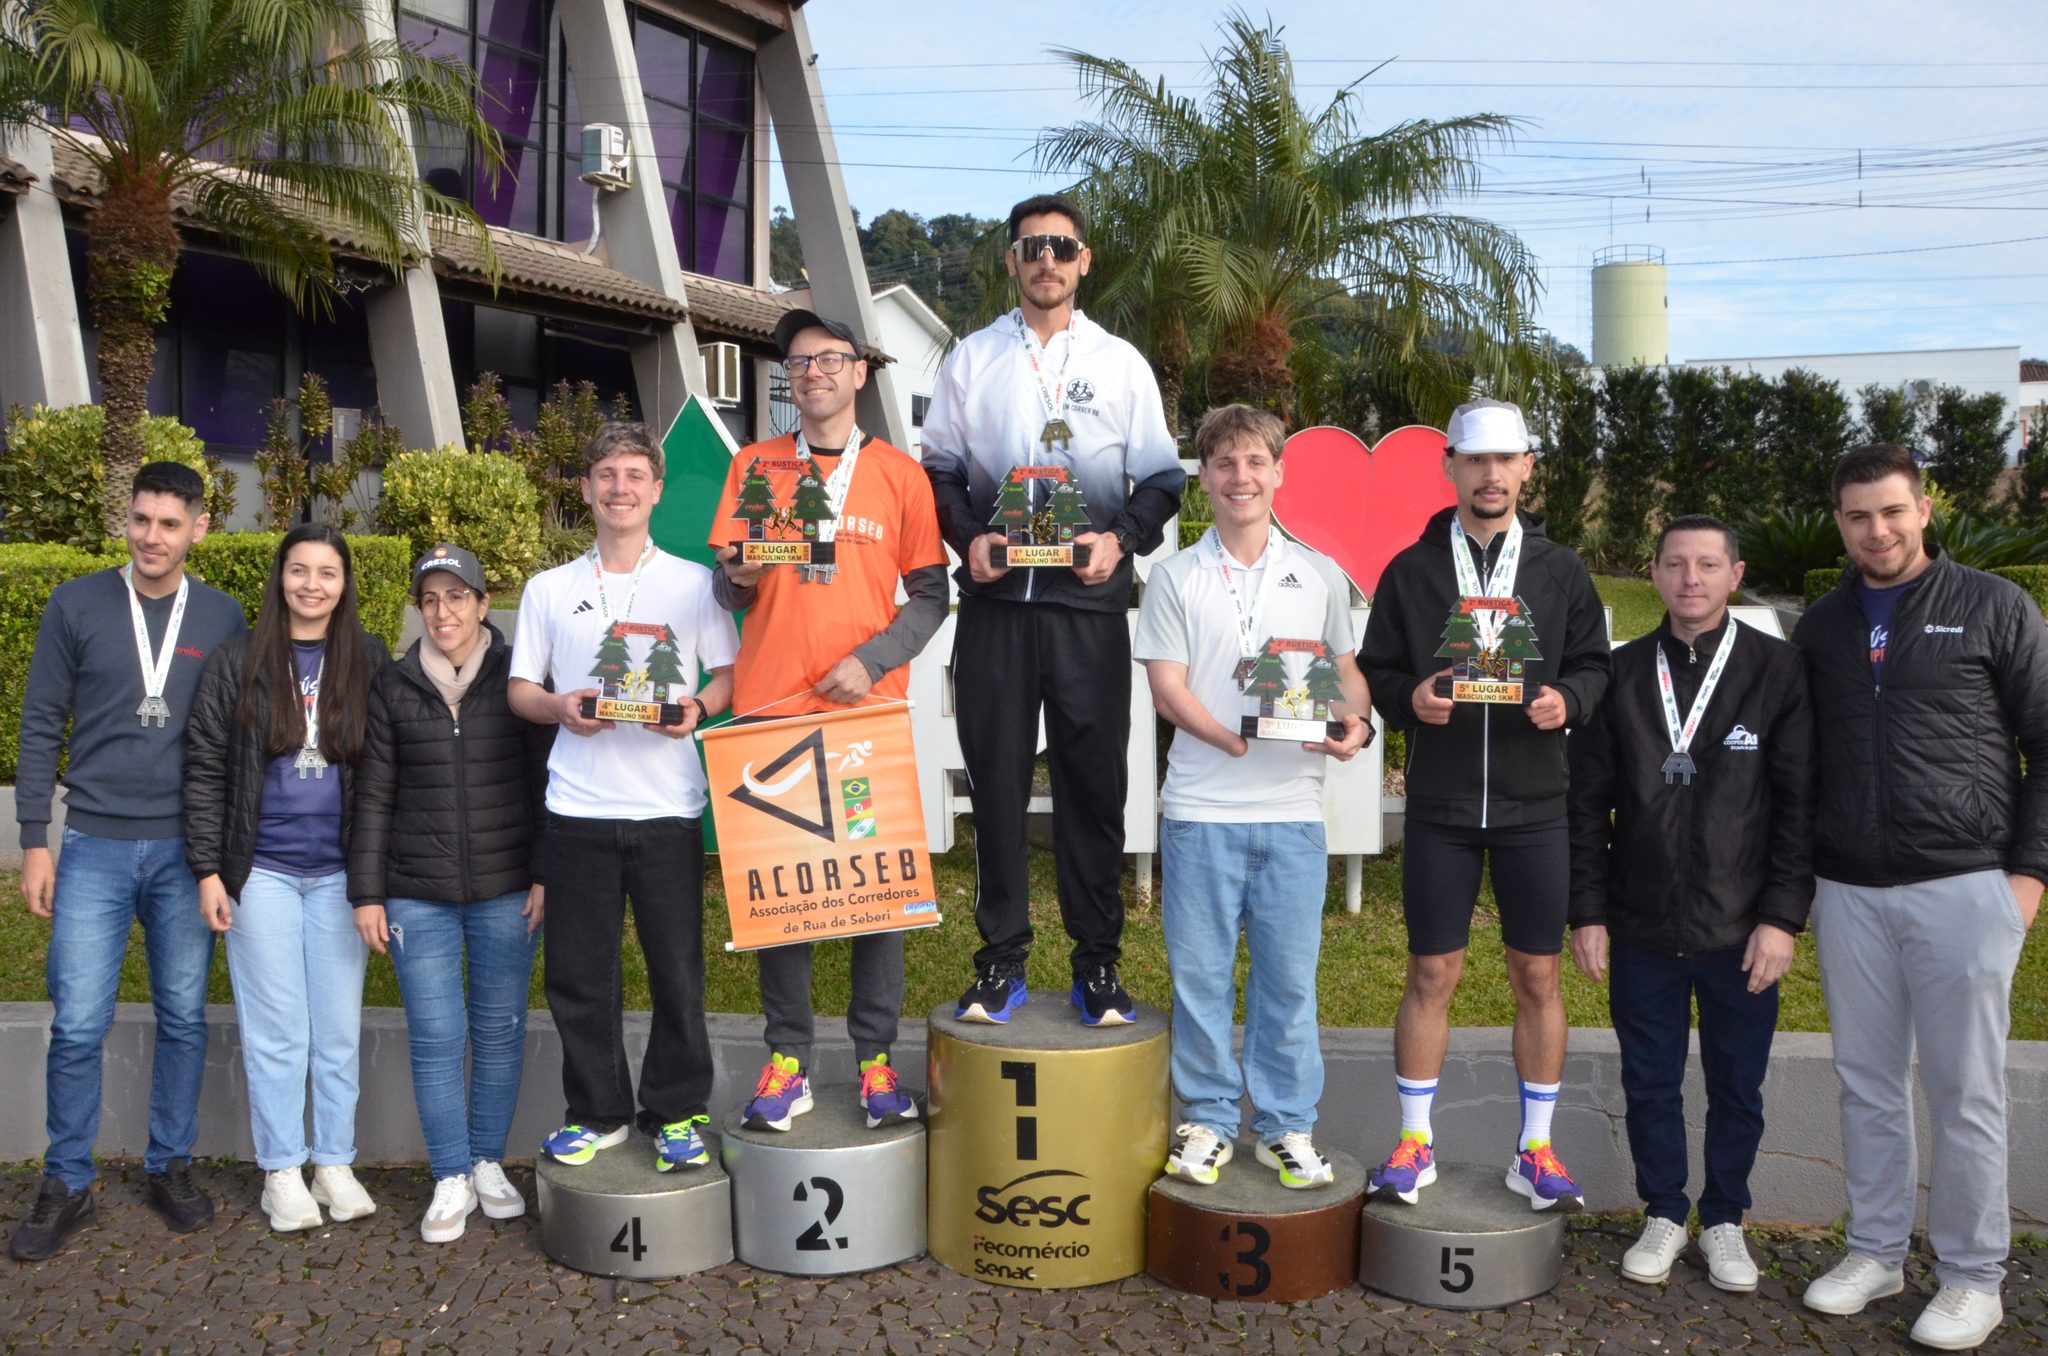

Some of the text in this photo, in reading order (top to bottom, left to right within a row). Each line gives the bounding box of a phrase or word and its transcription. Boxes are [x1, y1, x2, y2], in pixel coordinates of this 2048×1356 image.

[836, 515, 884, 540] ORSEB
[747, 554, 786, 562] MASCULINO
[762, 545, 797, 554] LUGAR
[1010, 557, 1049, 565] MASCULINO
[1025, 549, 1060, 557] LUGAR
[421, 557, 462, 570] CRESOL
[1934, 625, 1964, 634] Sicredi
[1456, 692, 1514, 702] MASCULINO 5KM
[1472, 684, 1509, 694] LUGAR
[599, 710, 652, 721] MASCULINO 5KM
[614, 703, 648, 713] LUGAR
[747, 848, 918, 902] ACORSEB
[749, 887, 920, 918] Associação dos Corredores
[783, 909, 891, 934] de Rua de Seberi
[1001, 1060, 1038, 1161] 1
[792, 1176, 849, 1250] 2
[974, 1185, 1091, 1228] Sesc
[610, 1216, 648, 1261] 4
[974, 1258, 1036, 1281] Senac
[1219, 1221, 1272, 1297] 3
[1439, 1246, 1475, 1293] 5
